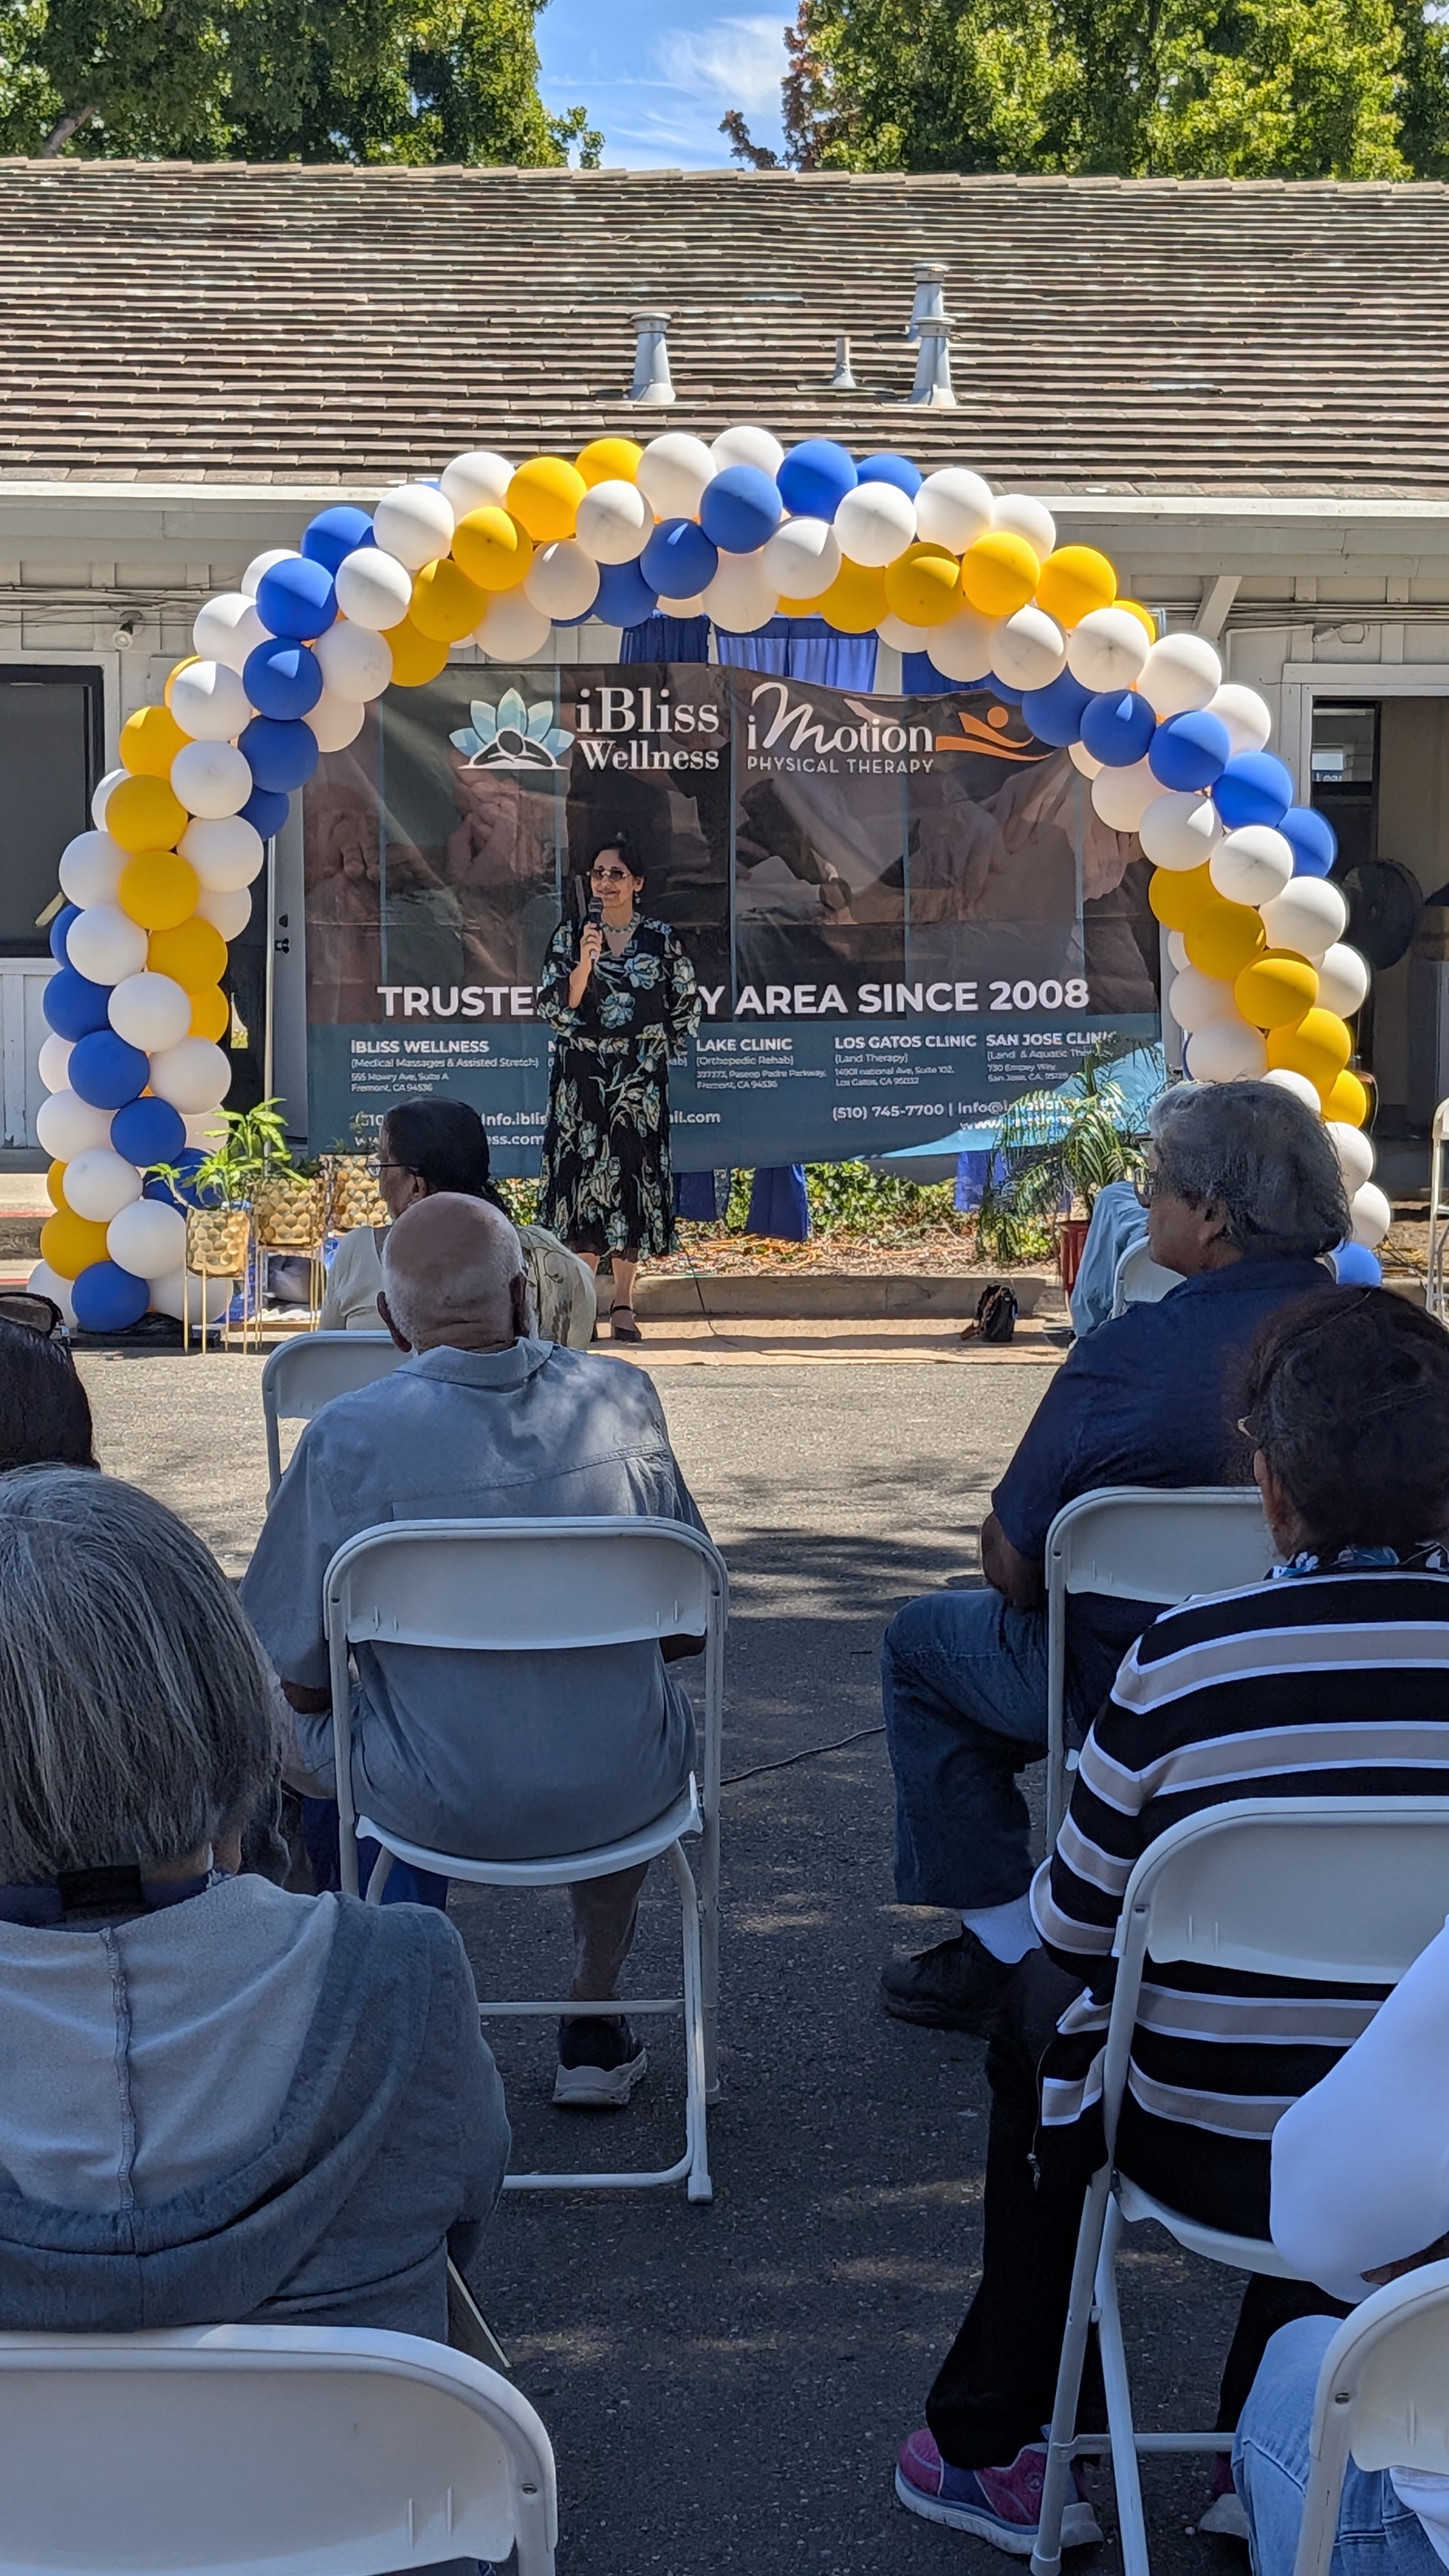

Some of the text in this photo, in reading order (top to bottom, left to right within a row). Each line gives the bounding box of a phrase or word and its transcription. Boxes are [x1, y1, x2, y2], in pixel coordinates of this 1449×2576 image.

[576, 687, 719, 733] iBliss
[577, 740, 720, 770] Wellness
[747, 755, 934, 774] PHYSICAL THERAPY
[376, 986, 544, 1016] TRUSTE
[734, 984, 848, 1015] AREA
[858, 981, 979, 1013] SINCE
[988, 979, 1090, 1011] 2008
[696, 1038, 793, 1052] LAKE CLINIC
[834, 1034, 977, 1049] LOS GATOS CLINIC
[986, 1034, 1019, 1046] SAN
[1022, 1032, 1063, 1046] JOSE
[403, 1040, 490, 1053] WELLNESS
[758, 1055, 794, 1066] Rehab)
[834, 1052, 908, 1064] (Land Therapy)
[987, 1050, 1016, 1061] (Land
[351, 1058, 394, 1069] (Medical
[395, 1058, 446, 1069] Massages
[456, 1057, 498, 1068] Assisted
[499, 1057, 539, 1069] Stretch)
[441, 1071, 450, 1080] A
[879, 1077, 893, 1085] CA
[392, 1083, 406, 1092] CA
[737, 1080, 751, 1089] CA
[832, 1106, 868, 1122] (510)
[871, 1103, 944, 1117] 745-7700
